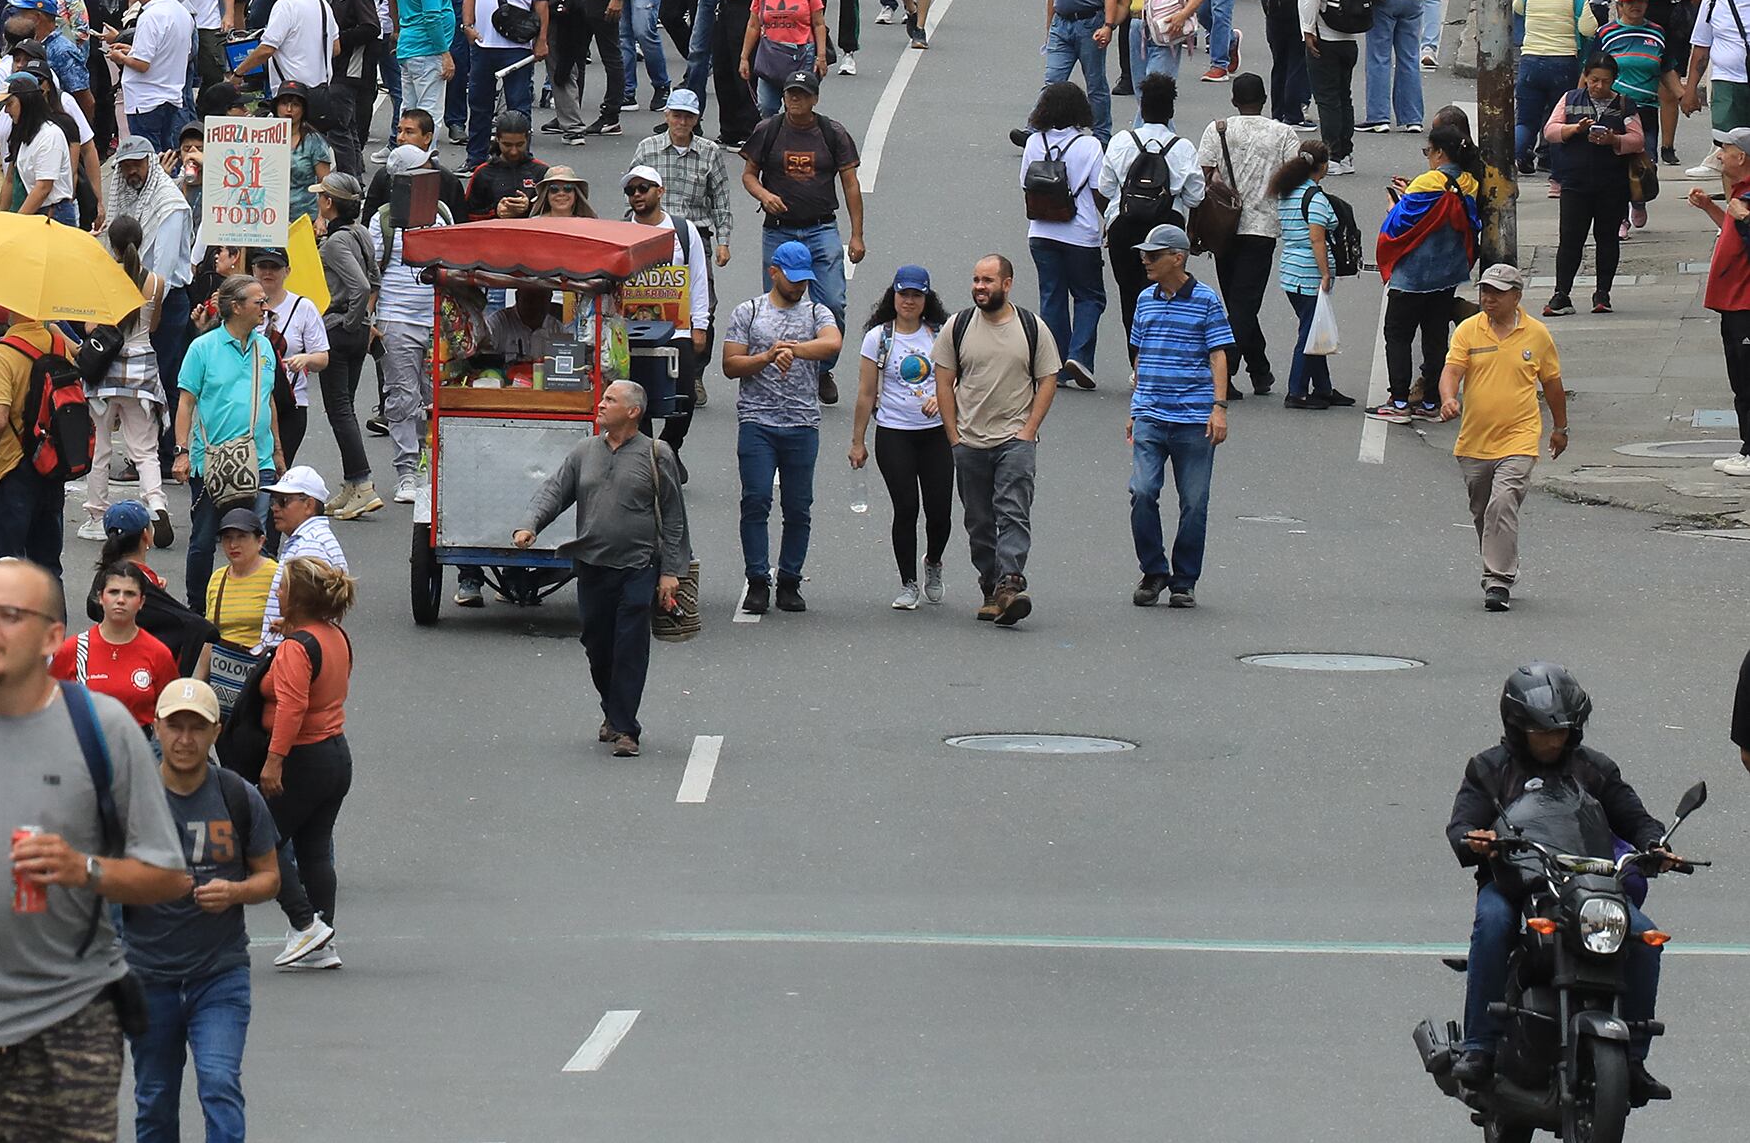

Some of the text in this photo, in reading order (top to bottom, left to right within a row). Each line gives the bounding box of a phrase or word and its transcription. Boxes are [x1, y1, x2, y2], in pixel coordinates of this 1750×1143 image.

[207, 121, 288, 145] ¡FUERZA PETRO!
[222, 147, 263, 189] SÍ
[236, 188, 253, 206] A
[212, 207, 277, 225] TODO
[187, 821, 235, 864] 75
